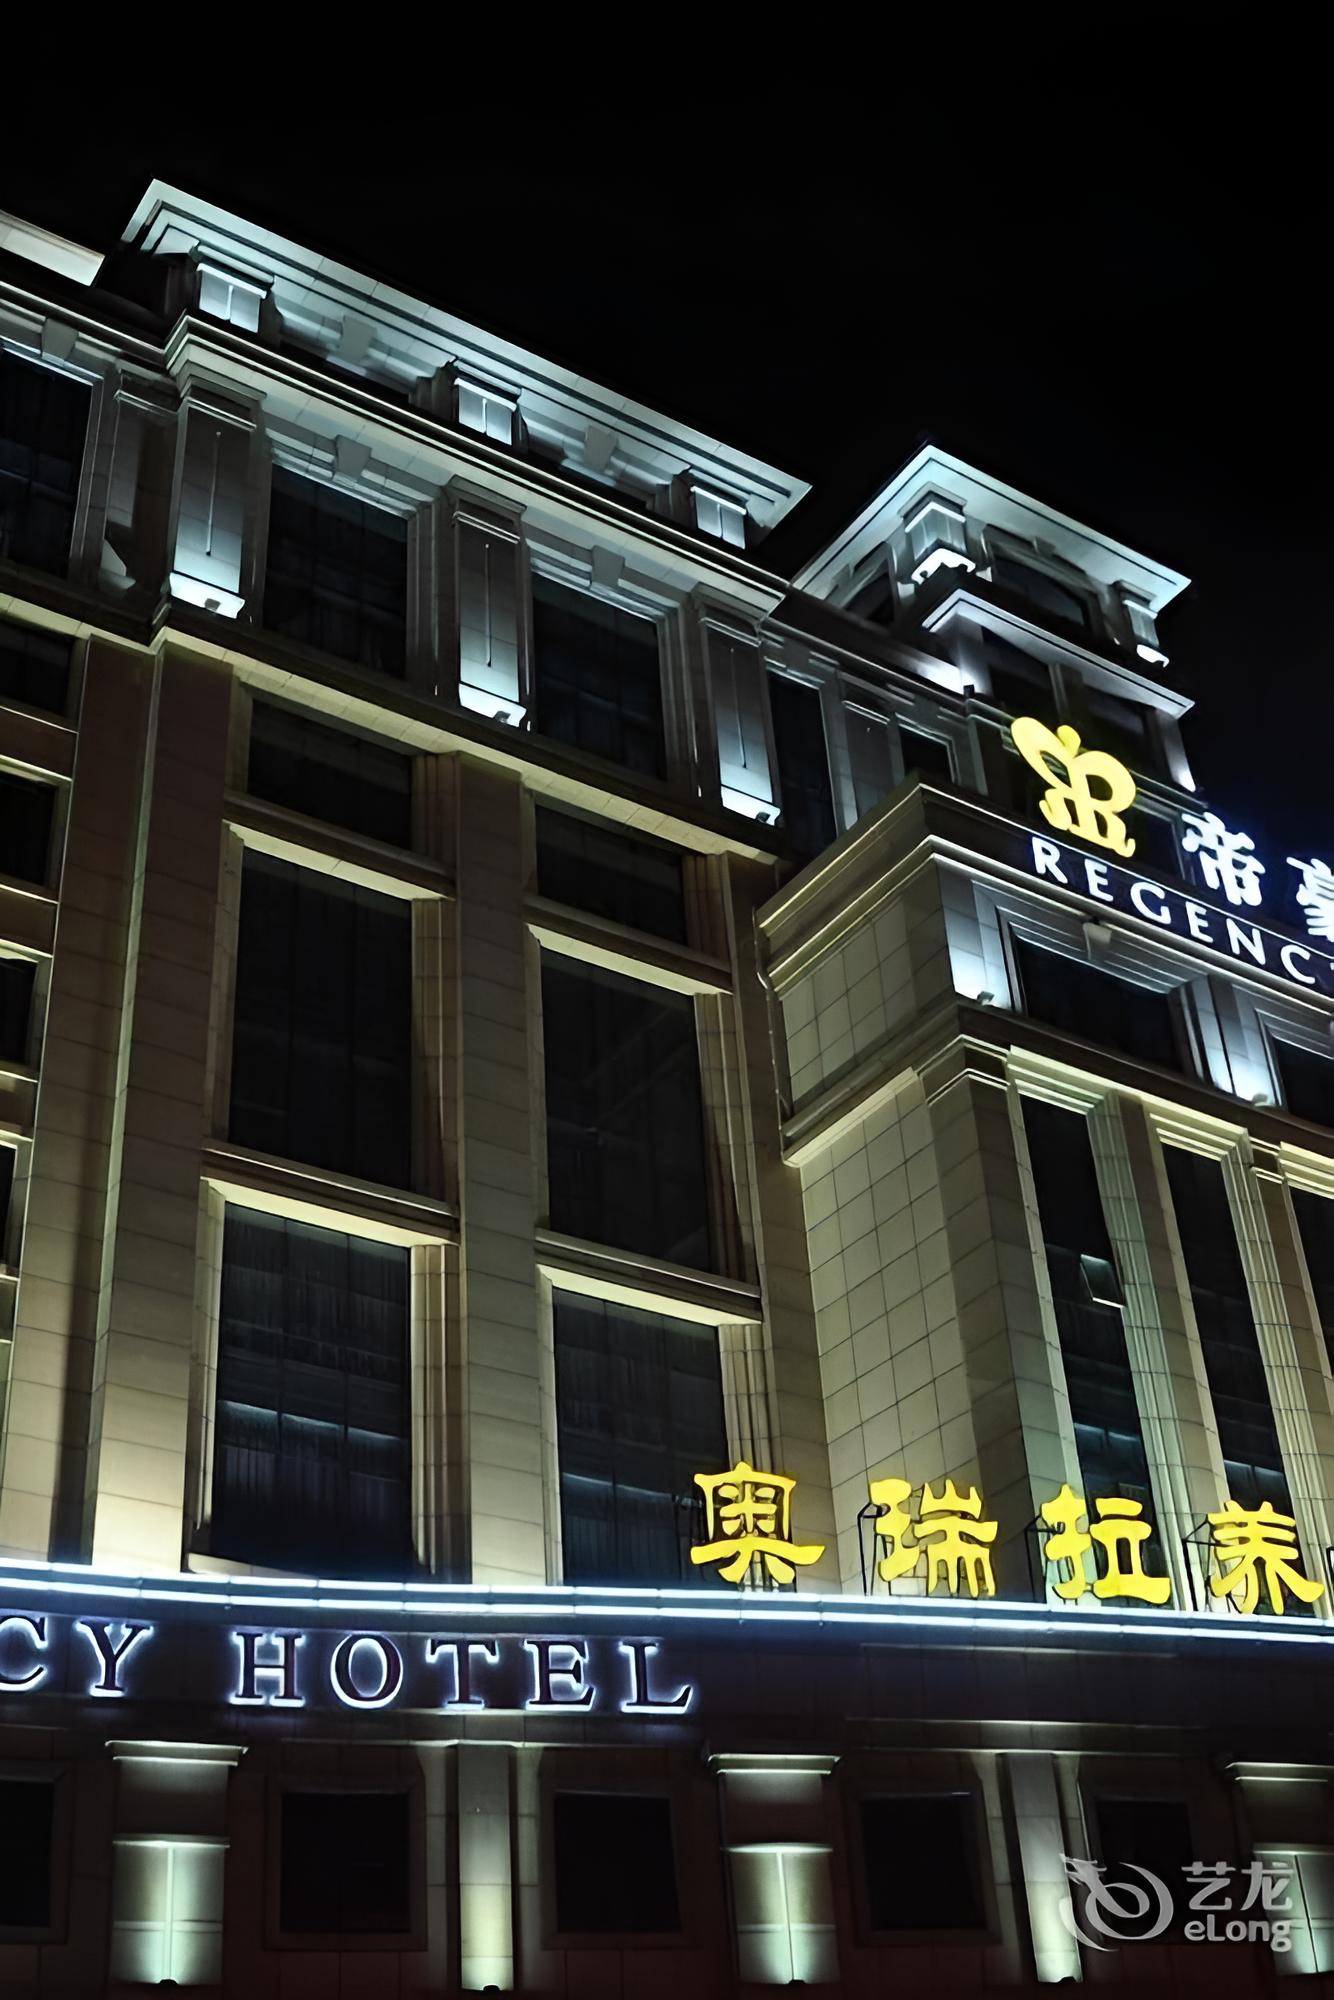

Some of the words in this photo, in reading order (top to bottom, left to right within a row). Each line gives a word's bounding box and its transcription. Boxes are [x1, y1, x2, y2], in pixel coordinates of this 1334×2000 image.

[1031, 836, 1334, 985] REGENC
[691, 1461, 1325, 1615] 奥瑞拉养
[229, 1630, 694, 1714] HOTEL
